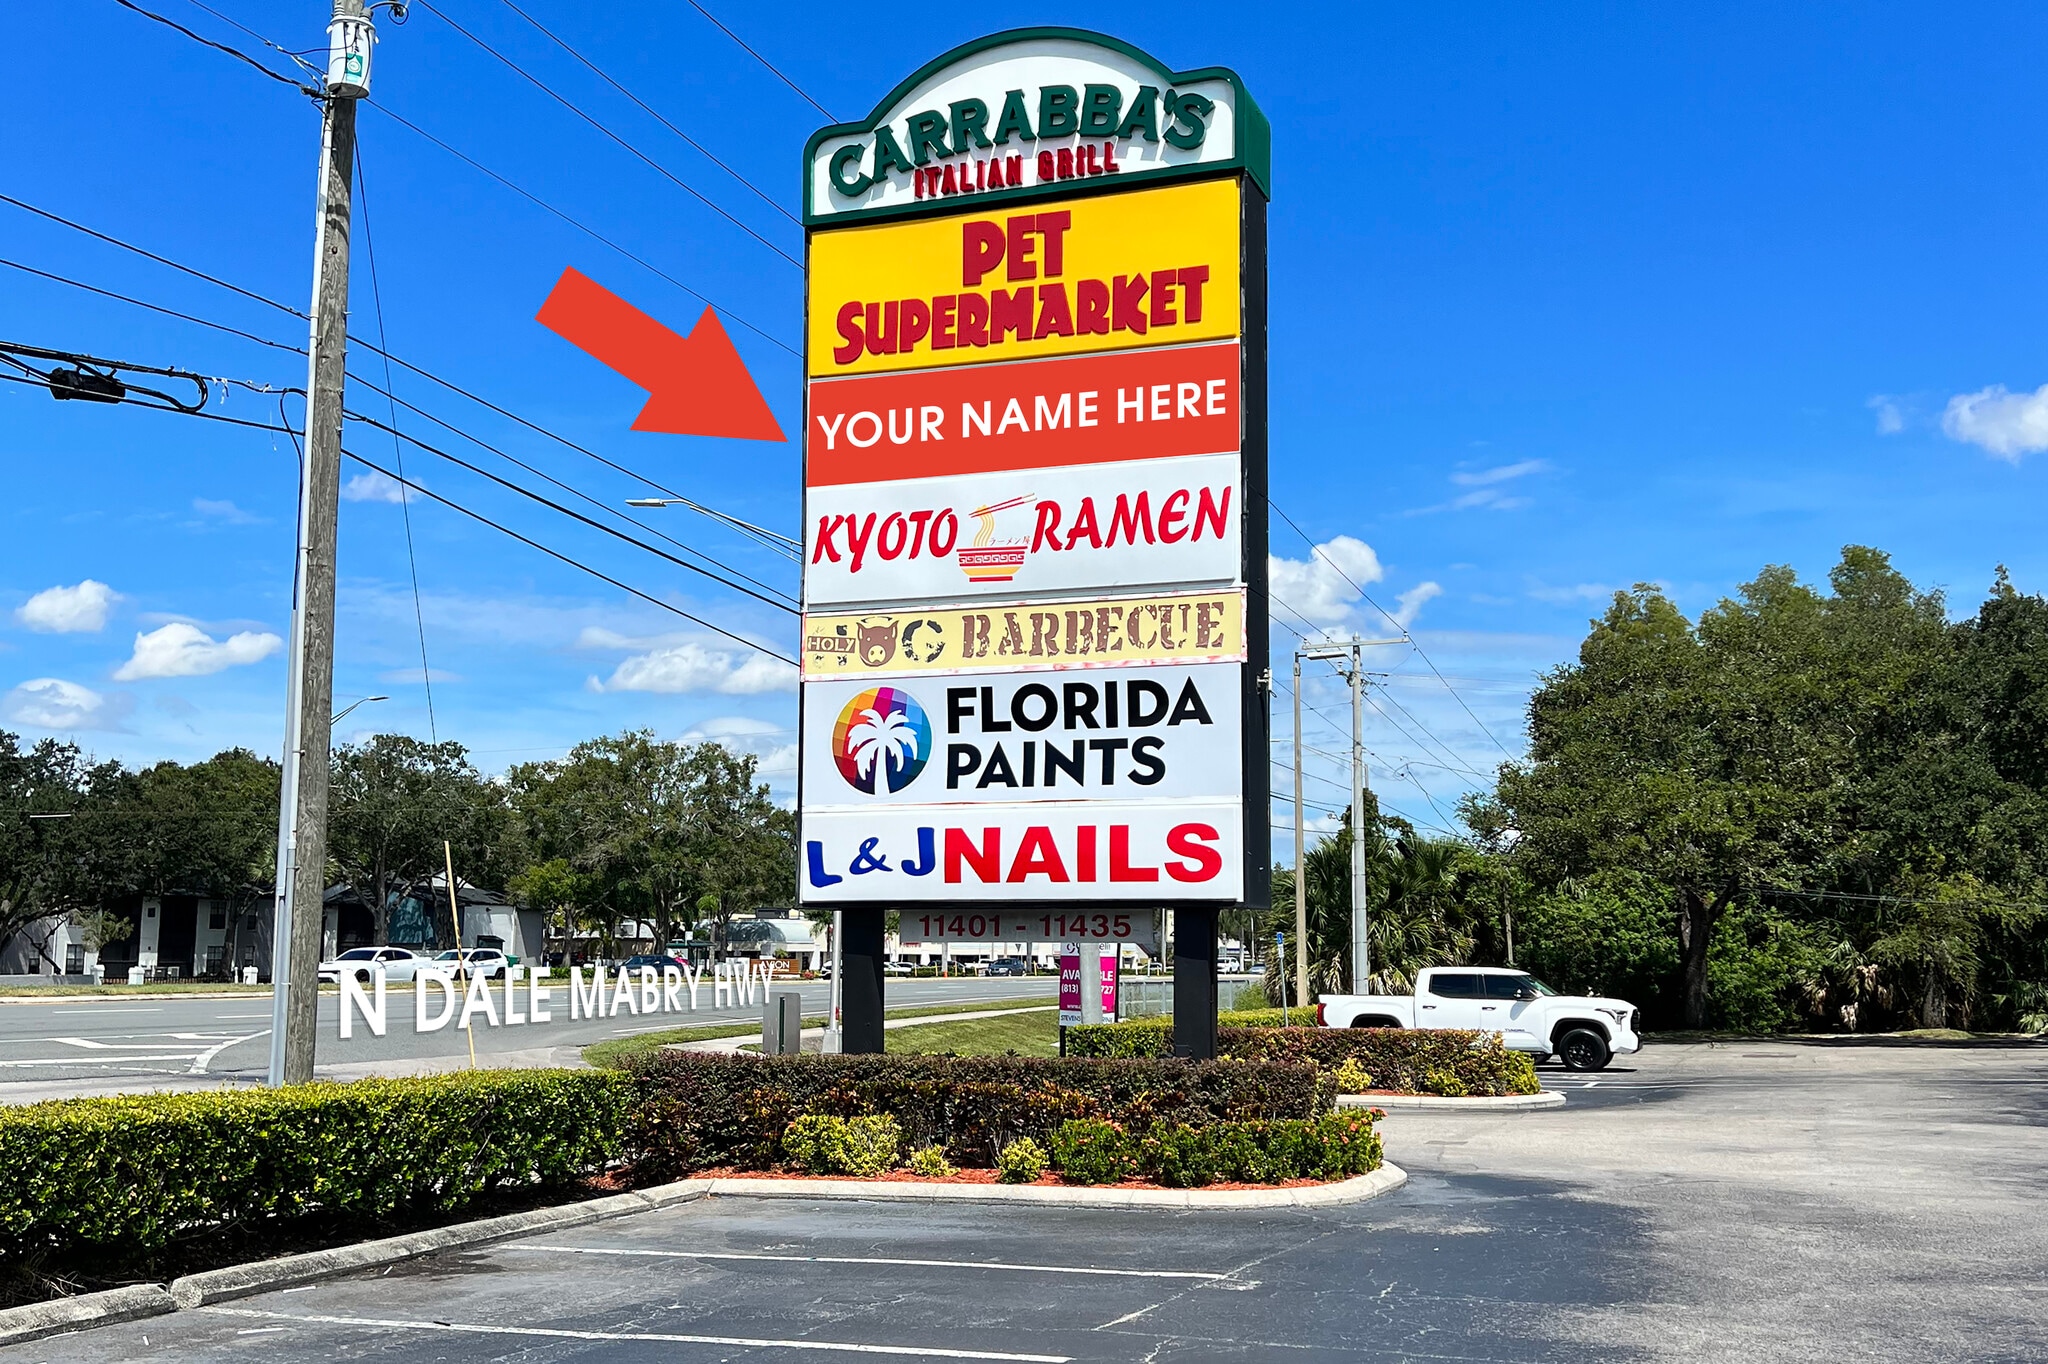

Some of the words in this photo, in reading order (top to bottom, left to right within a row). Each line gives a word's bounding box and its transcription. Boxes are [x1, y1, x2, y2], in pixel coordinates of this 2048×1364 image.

[829, 83, 1216, 197] CARRABBA'S
[914, 155, 1023, 199] ITALIAN
[1037, 142, 1120, 182] GRILL
[962, 210, 1071, 287] PET
[833, 265, 1209, 366] SUPERMARKET
[812, 507, 958, 573] KYOTO
[1030, 486, 1232, 554] RAMEN
[807, 637, 855, 652] HOLY
[962, 602, 1225, 659] BARBECUE
[946, 676, 1213, 734] FLORIDA
[946, 736, 1166, 790] PAINTS
[807, 841, 843, 888] L
[850, 836, 894, 875] &
[944, 823, 1223, 884] NAILS
[919, 914, 1001, 937] 11401
[1039, 914, 1132, 938] 11435
[1061, 983, 1079, 993] (813)
